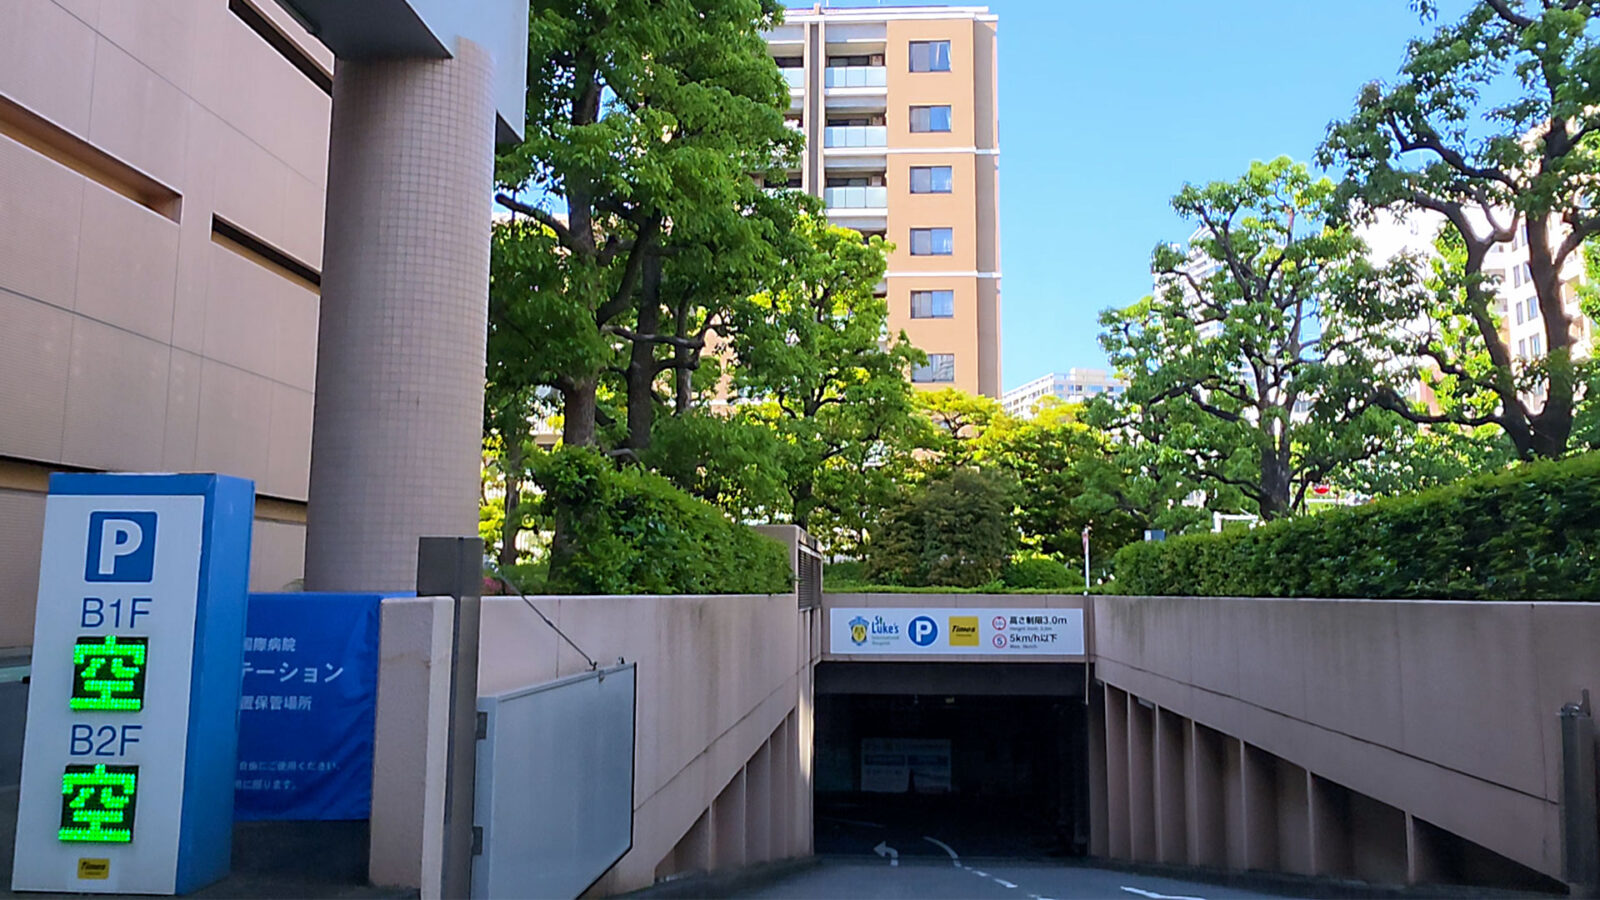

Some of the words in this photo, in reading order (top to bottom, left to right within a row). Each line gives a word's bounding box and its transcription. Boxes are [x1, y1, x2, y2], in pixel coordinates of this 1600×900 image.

[99, 518, 143, 575] P
[81, 597, 152, 628] B1F
[871, 621, 899, 634] Luke's
[1009, 616, 1068, 625] 高さ制限3.0m
[916, 620, 932, 642] P
[1009, 633, 1058, 643] 5km/h以下
[70, 635, 146, 711] 空
[70, 725, 143, 756] B2F
[58, 764, 137, 842] 空
